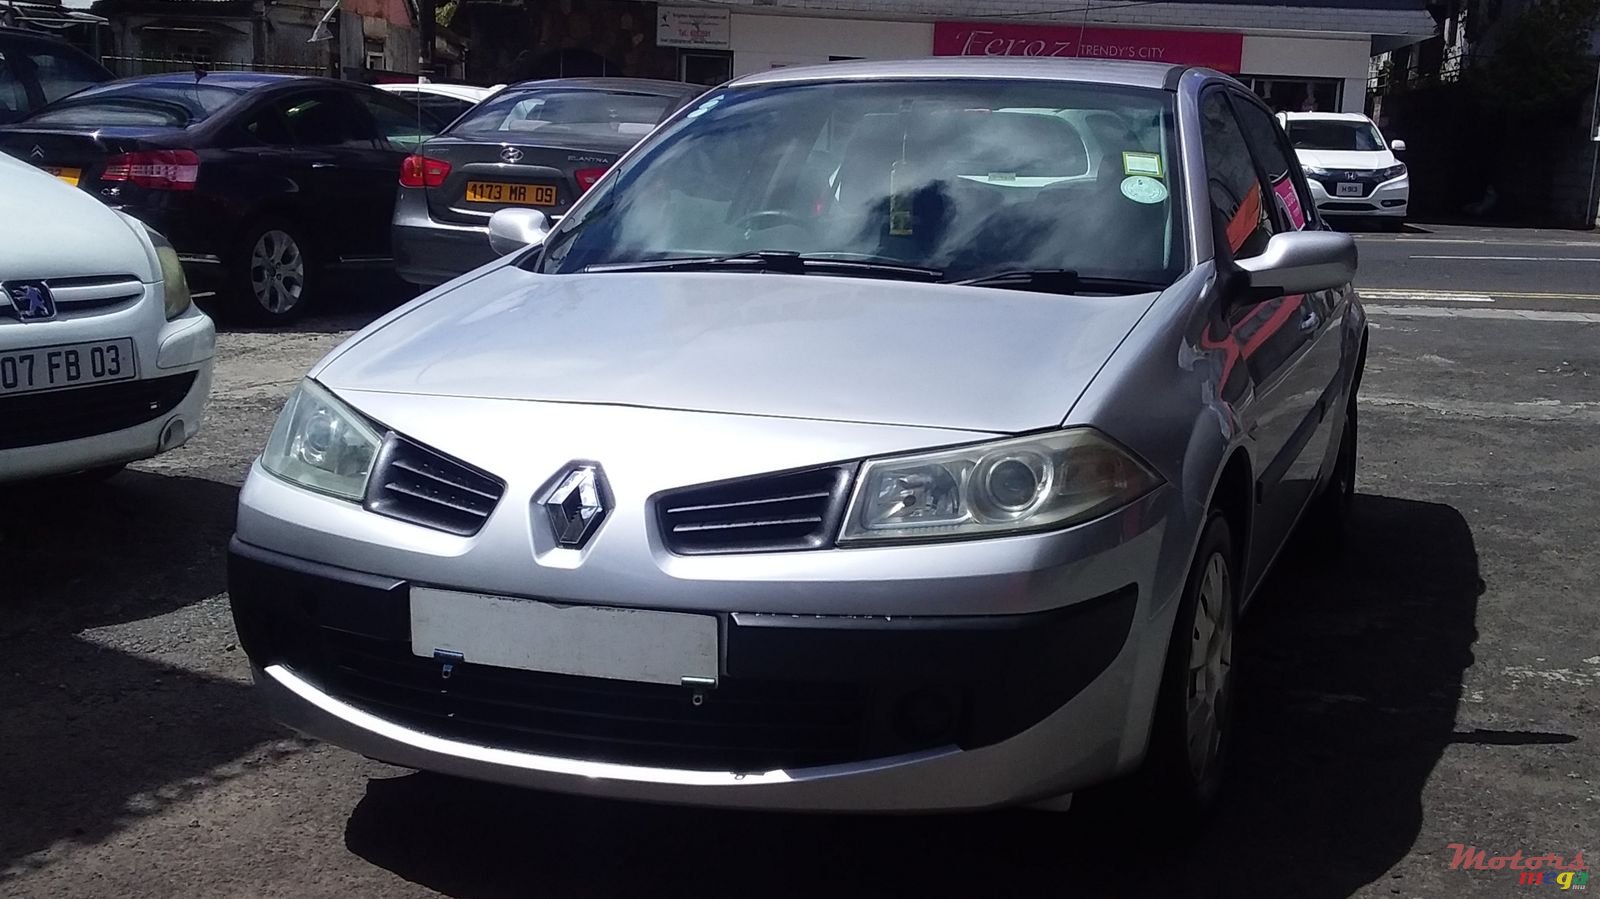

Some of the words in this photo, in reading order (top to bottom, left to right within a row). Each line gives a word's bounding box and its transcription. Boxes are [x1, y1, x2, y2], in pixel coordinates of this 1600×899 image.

[1081, 45, 1135, 57] TRENDY'S
[1138, 47, 1165, 58] CITY
[470, 183, 502, 200] 1173
[509, 186, 527, 201] MR
[535, 188, 553, 203] 09
[0, 354, 35, 389] 07
[47, 349, 81, 384] FB
[90, 345, 121, 378] 03
